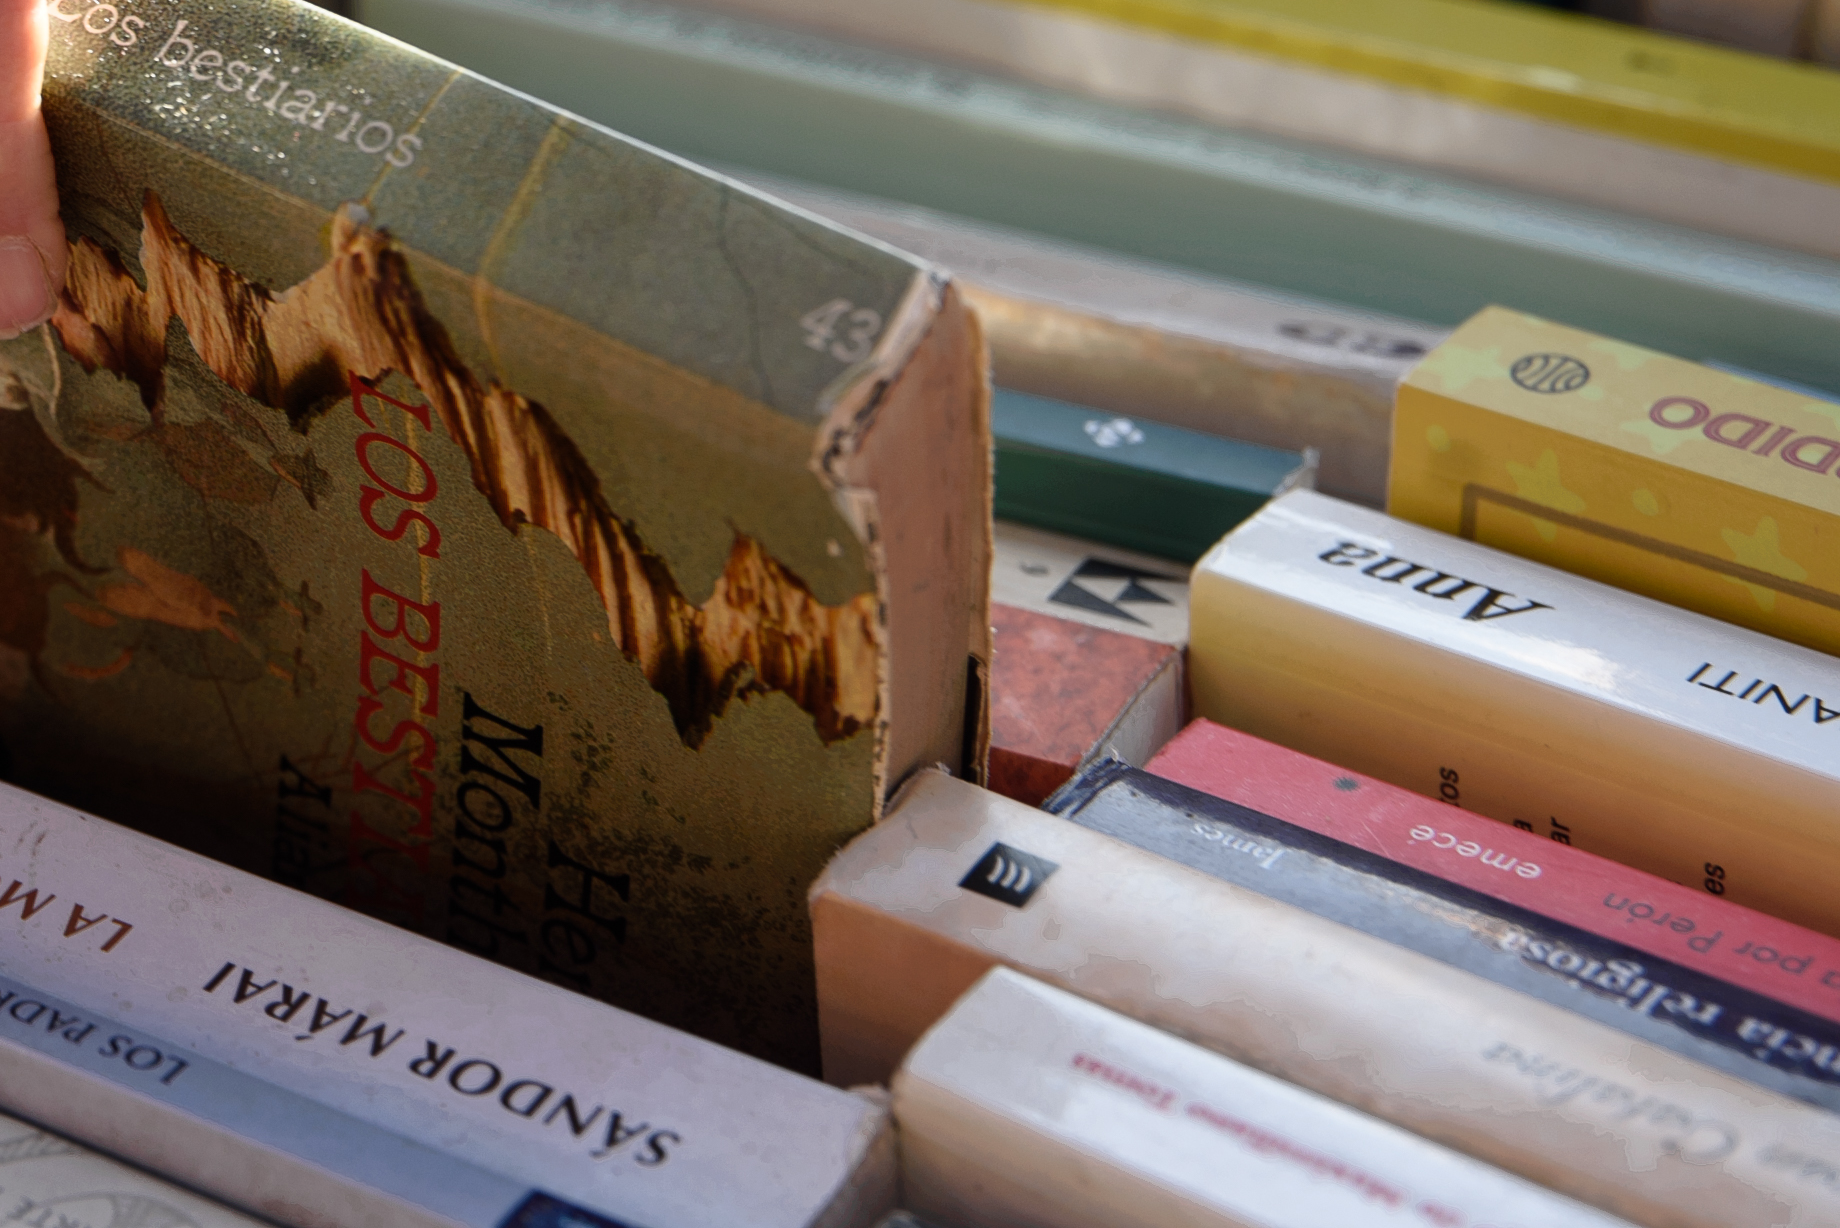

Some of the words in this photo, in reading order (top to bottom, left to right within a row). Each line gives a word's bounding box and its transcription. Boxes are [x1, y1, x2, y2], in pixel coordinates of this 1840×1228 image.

[153, 19, 424, 169] bestiarios
[799, 297, 882, 364] 43
[348, 370, 442, 559] LOS
[1649, 395, 1840, 480] DIDO
[1317, 538, 1555, 622] Anna
[1189, 821, 1289, 869] James
[1407, 823, 1542, 880] emecé
[63, 902, 135, 953] LA
[1603, 890, 1723, 954] Perón
[1734, 940, 1816, 975] por
[202, 961, 405, 1057] MÁRAI
[1499, 930, 1724, 1029] religiosa
[97, 1033, 190, 1086] LOS
[408, 1039, 682, 1166] SÁNDOR
